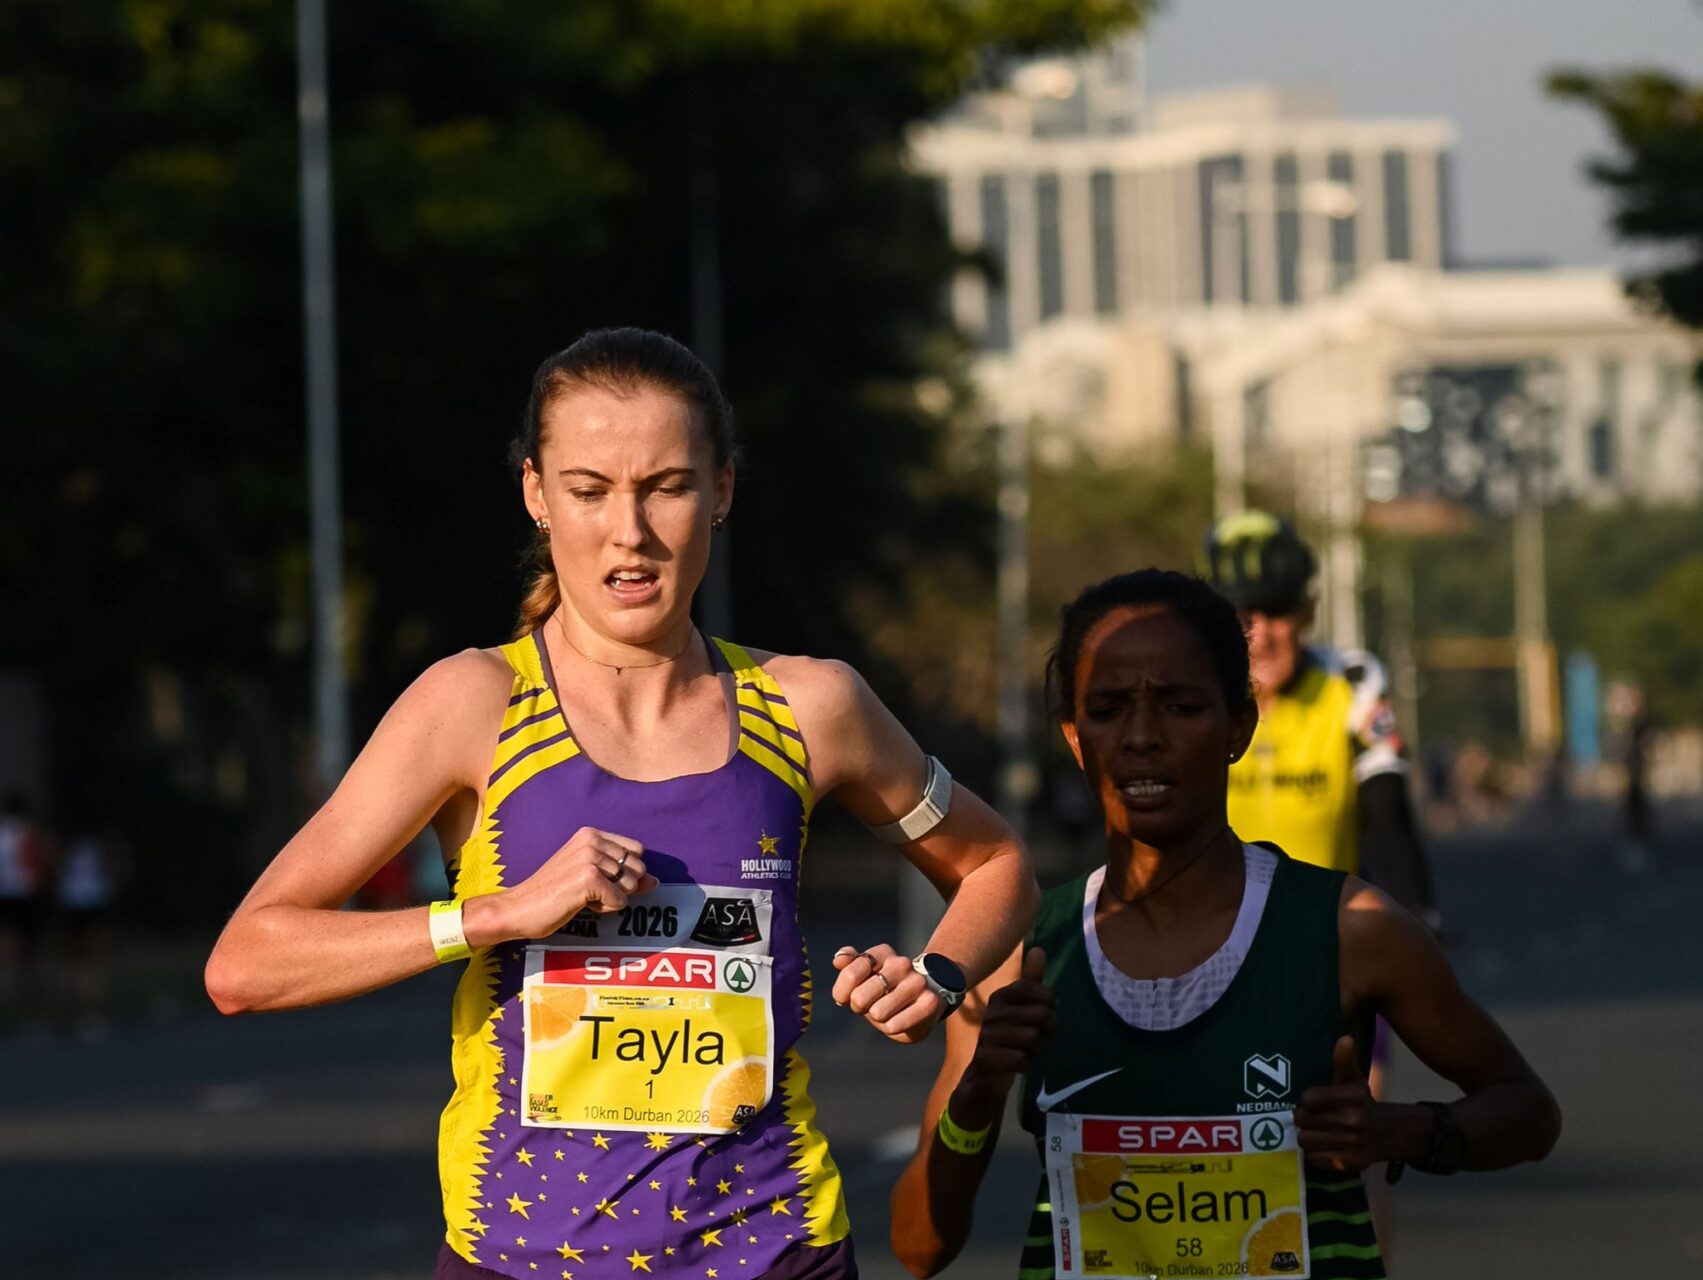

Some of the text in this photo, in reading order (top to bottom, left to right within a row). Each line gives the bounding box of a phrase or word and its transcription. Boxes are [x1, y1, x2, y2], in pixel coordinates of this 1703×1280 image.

[741, 859, 792, 872] HOLLYWOOD
[740, 872, 779, 880] ATHLETICS
[618, 905, 678, 937] 2026
[703, 903, 752, 926] ASA
[584, 957, 714, 983] SPAR
[579, 1015, 724, 1074] Tayla
[644, 1079, 654, 1099] 1
[584, 1106, 710, 1123] 10km Durban 2026
[1051, 1136, 1062, 1152] 58
[1118, 1126, 1240, 1149] SPAR
[1110, 1181, 1267, 1224] Selam
[1176, 1238, 1203, 1257] 58
[1167, 1262, 1214, 1276] Durban
[1217, 1261, 1250, 1275] 2026
[1274, 1254, 1296, 1265] ASA
